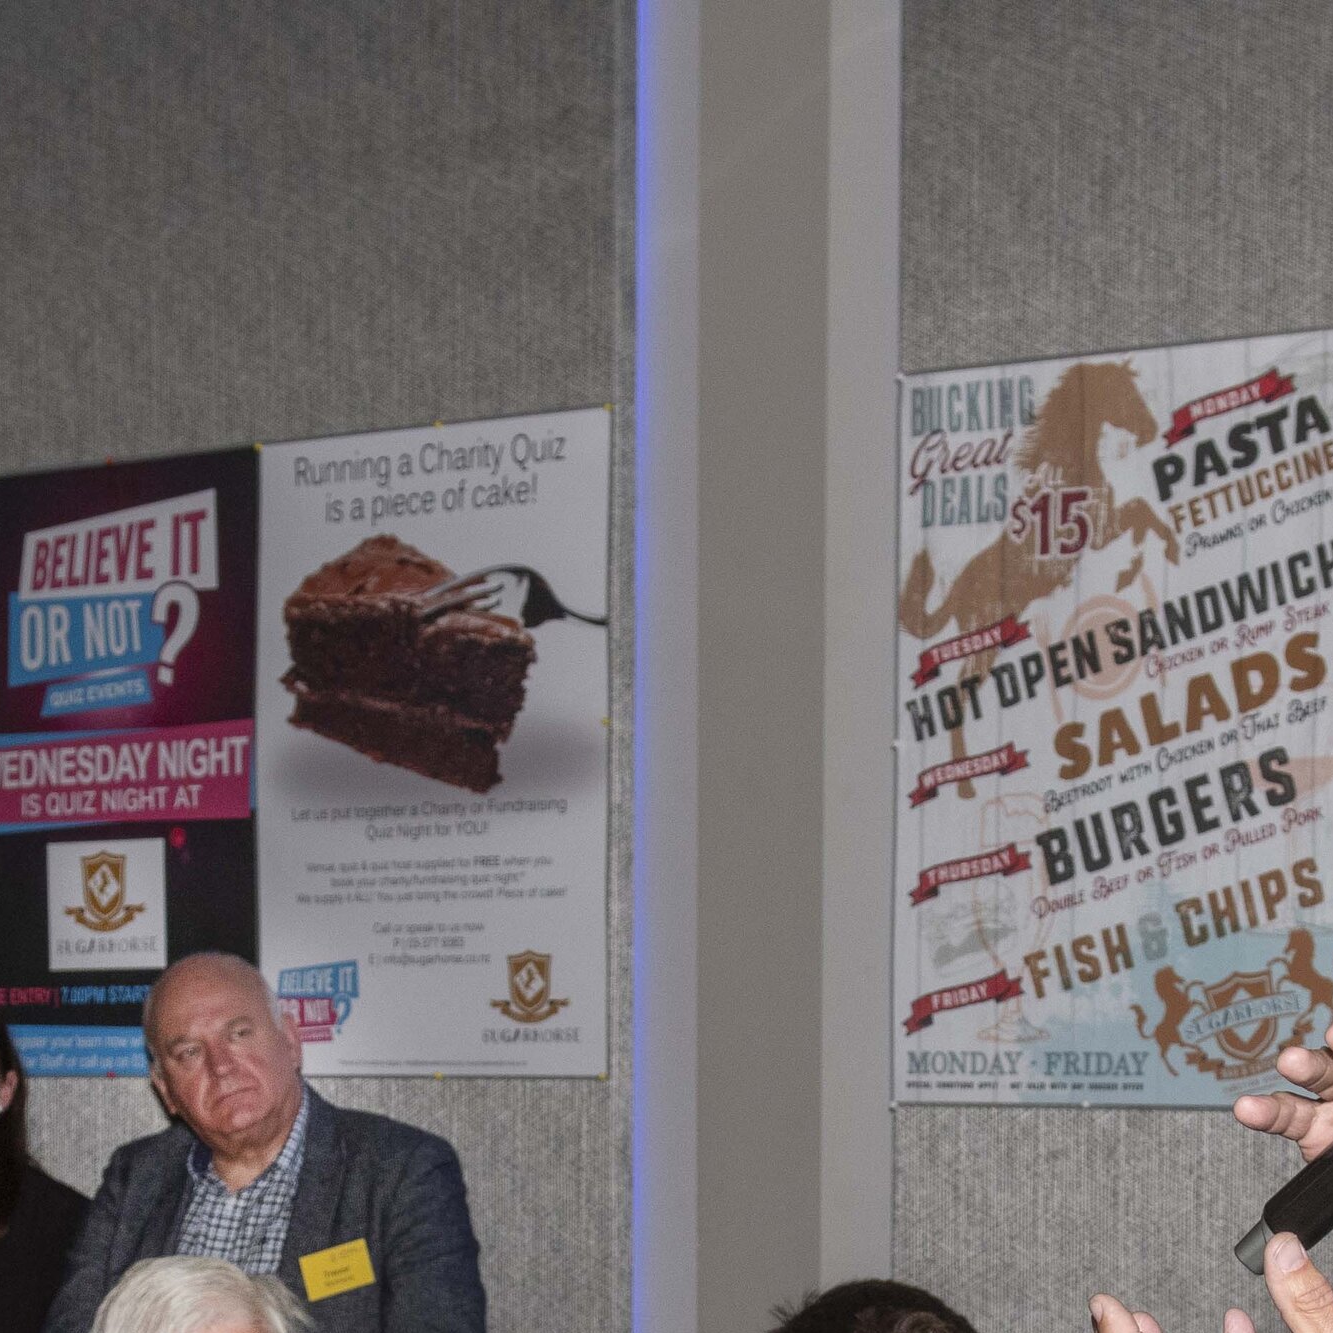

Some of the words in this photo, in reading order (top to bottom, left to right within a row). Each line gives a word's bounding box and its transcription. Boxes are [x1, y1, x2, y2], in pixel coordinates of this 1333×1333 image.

[911, 374, 1036, 436] BUCKING
[1190, 382, 1263, 420] MONDAY
[294, 451, 391, 487] Running
[397, 453, 413, 477] a
[419, 436, 505, 475] Charity
[511, 429, 566, 470] Quiz
[909, 427, 1014, 495] Great
[1152, 395, 1332, 502] PASTA
[325, 493, 344, 524] is
[349, 496, 365, 520] a
[371, 490, 436, 525] piece
[441, 479, 466, 511] of
[470, 472, 538, 509] cake!
[920, 473, 1008, 528] DEALS
[1010, 487, 1090, 557] $15
[31, 517, 157, 592] BELIEVE
[171, 509, 208, 577] IT
[19, 602, 72, 672] OR
[83, 599, 143, 662] NOT
[930, 626, 1003, 660] TUESDAY
[905, 673, 984, 742] HOT
[989, 630, 1104, 710] OPEN
[1053, 630, 1329, 781] SALADS
[157, 735, 249, 778] NIGHT
[922, 750, 1011, 786] WEDNESDAY
[20, 793, 43, 817] IS
[45, 789, 97, 816] QUIZ
[101, 785, 169, 812] NIGHT
[172, 784, 203, 808] AT
[354, 802, 408, 823] together
[487, 798, 567, 814] Fundraising
[1036, 746, 1297, 885] BURGERS
[365, 823, 394, 841] Quiz
[397, 822, 431, 841] Night
[928, 849, 1012, 885] THURSDAY
[1024, 923, 1136, 999] FISH
[1174, 857, 1325, 949] CHIPS
[281, 968, 334, 995] BELIEVE
[338, 965, 354, 993] IT
[930, 982, 988, 1011] FRIDAY
[906, 1049, 1024, 1077] MONDAY
[1043, 1049, 1150, 1077] FRIDAY
